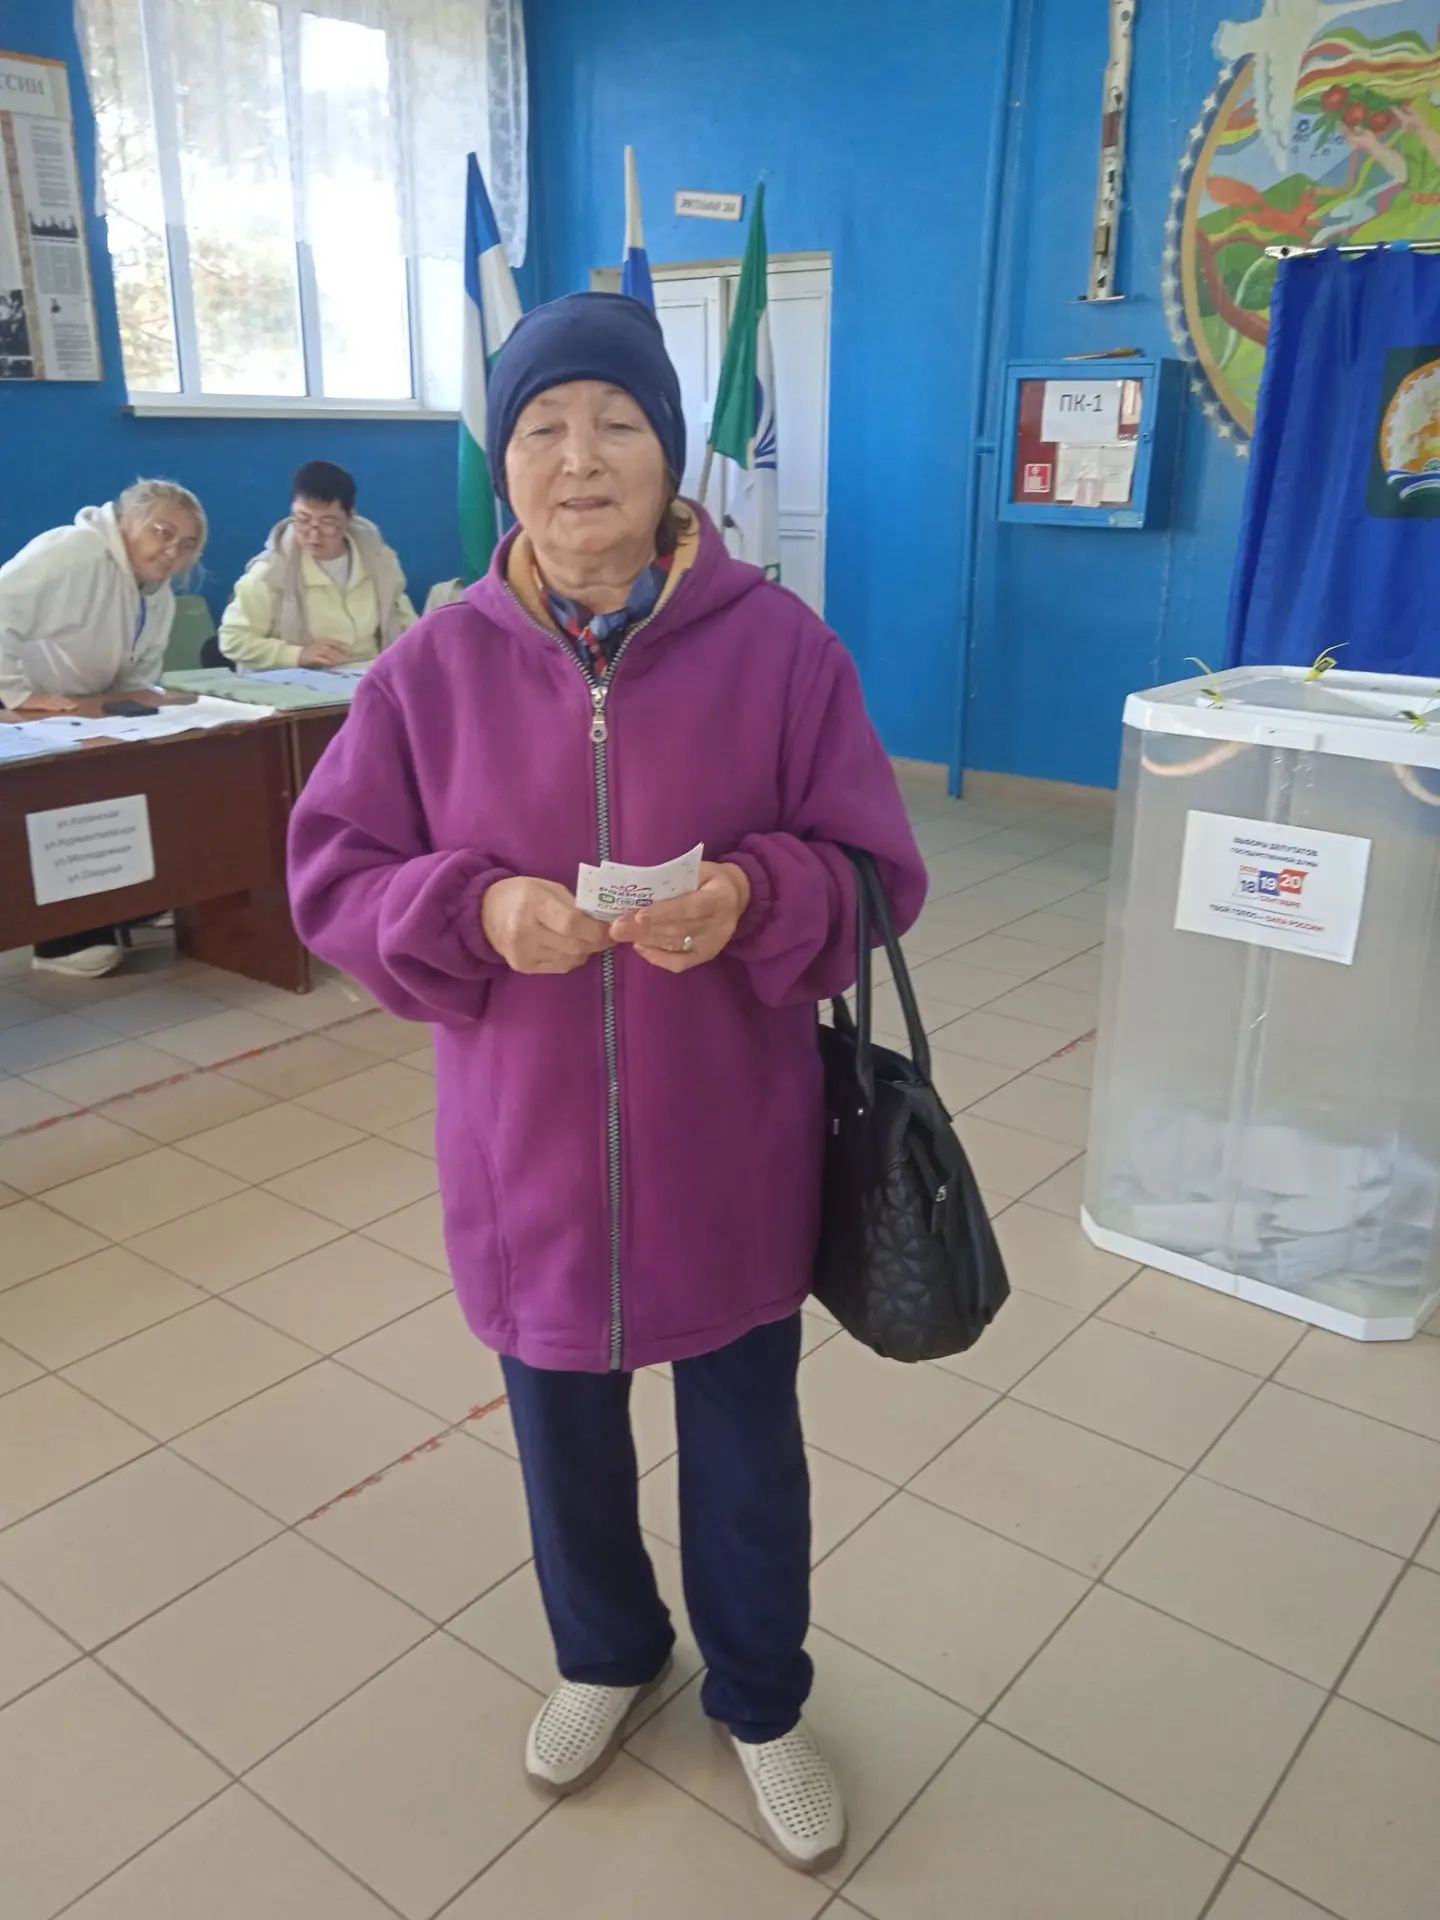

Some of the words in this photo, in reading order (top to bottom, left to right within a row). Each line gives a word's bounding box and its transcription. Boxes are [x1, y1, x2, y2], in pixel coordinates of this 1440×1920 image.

[1059, 394, 1103, 412] ПК-1
[1240, 879, 1256, 894] 18
[1260, 876, 1277, 891] 19
[1280, 873, 1301, 889] 20
